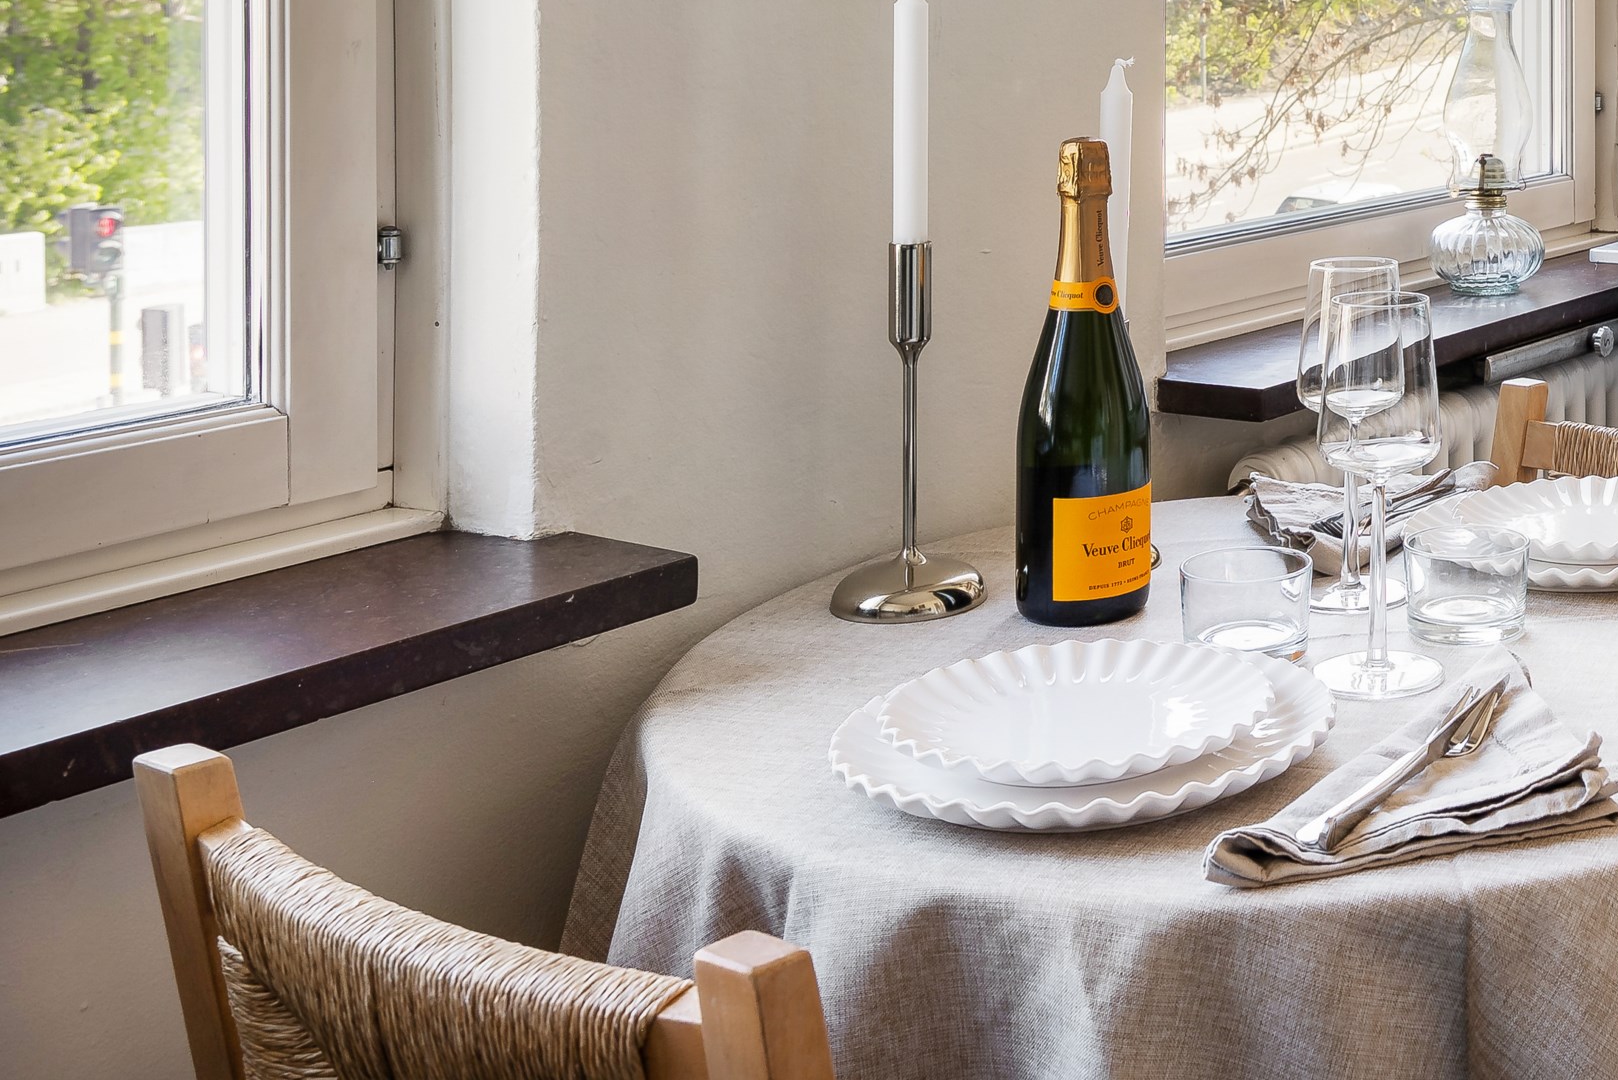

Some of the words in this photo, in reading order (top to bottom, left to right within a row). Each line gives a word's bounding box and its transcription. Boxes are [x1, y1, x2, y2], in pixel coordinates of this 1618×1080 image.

[1096, 210, 1105, 242] Clicquot
[1097, 245, 1105, 267] Veuve
[1082, 542, 1119, 557] Veuve
[1118, 558, 1135, 569] BRUT
